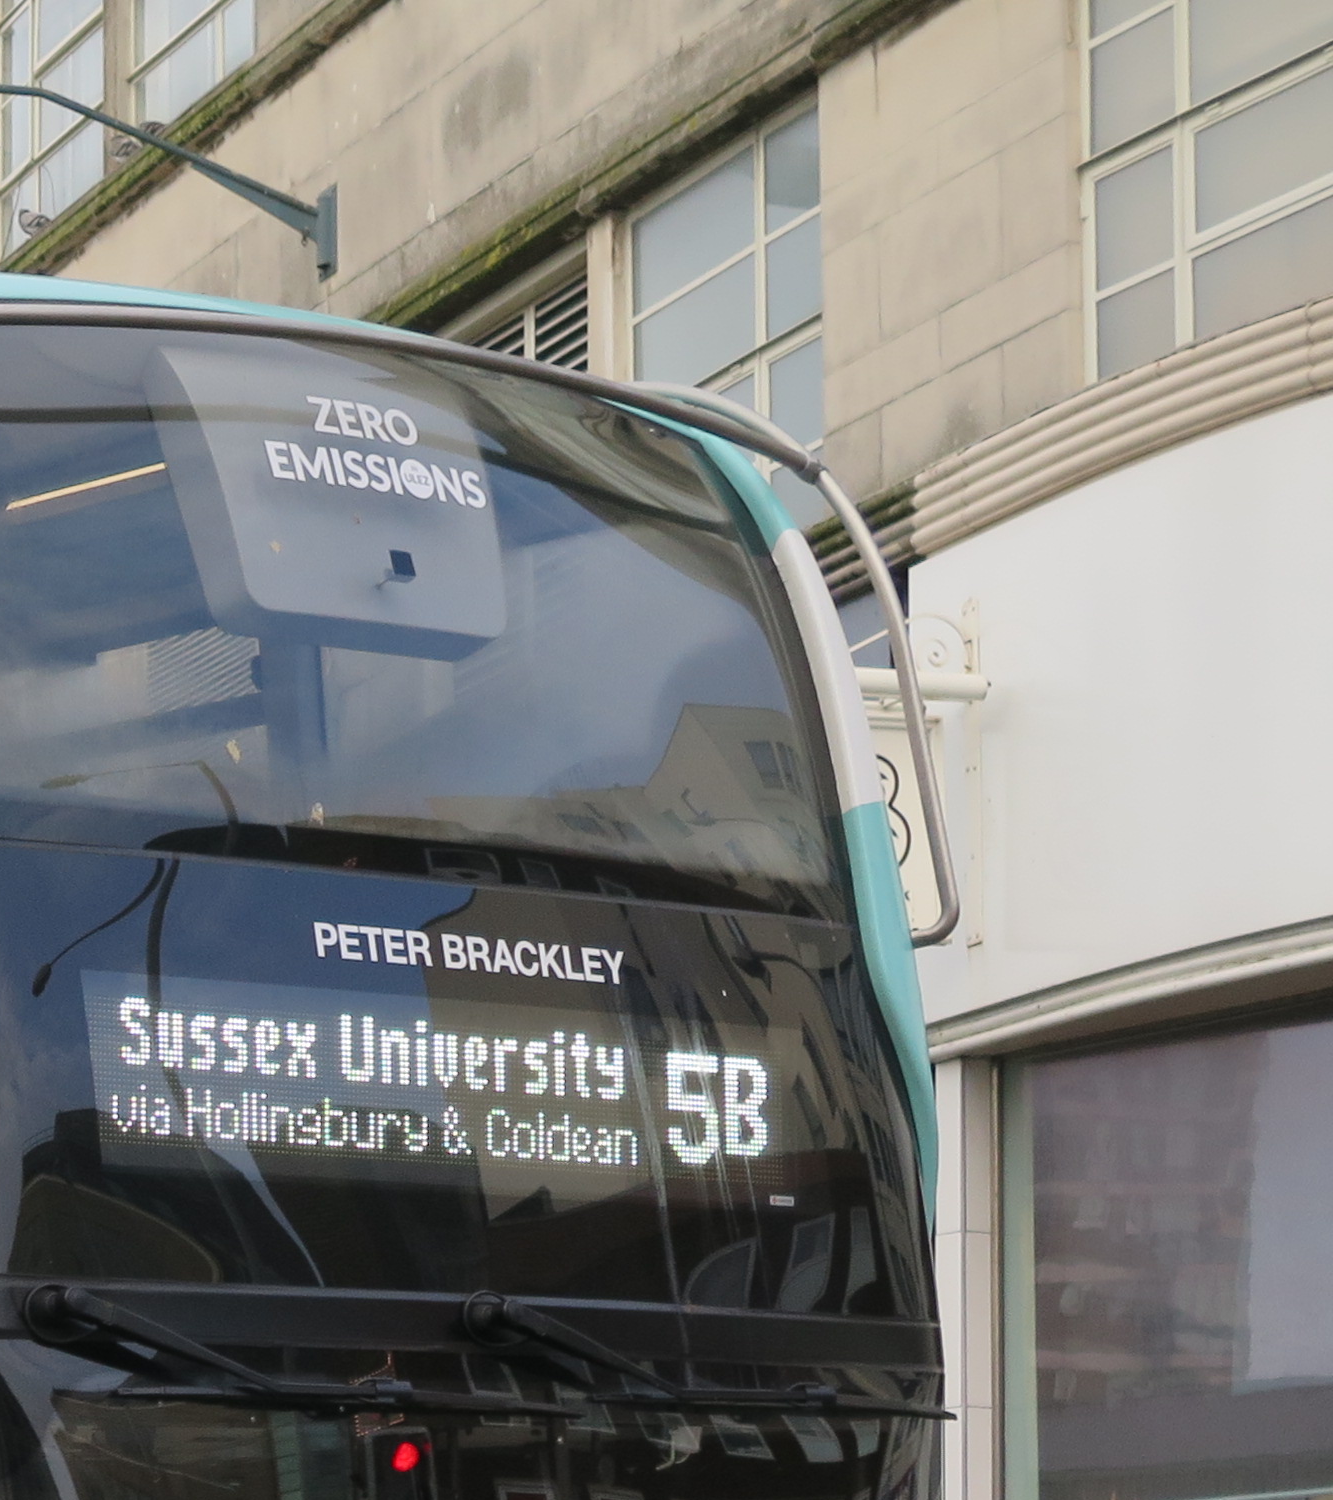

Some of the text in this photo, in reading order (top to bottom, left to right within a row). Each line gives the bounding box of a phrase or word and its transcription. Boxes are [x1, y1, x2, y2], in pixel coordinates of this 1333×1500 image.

[306, 395, 418, 446] ZERO
[313, 922, 624, 985] PETER BRACKLEY
[119, 996, 625, 1100] Sussex University
[110, 1084, 638, 1166] via Hollinsbury & Coldean
[665, 1051, 768, 1165] 5B
